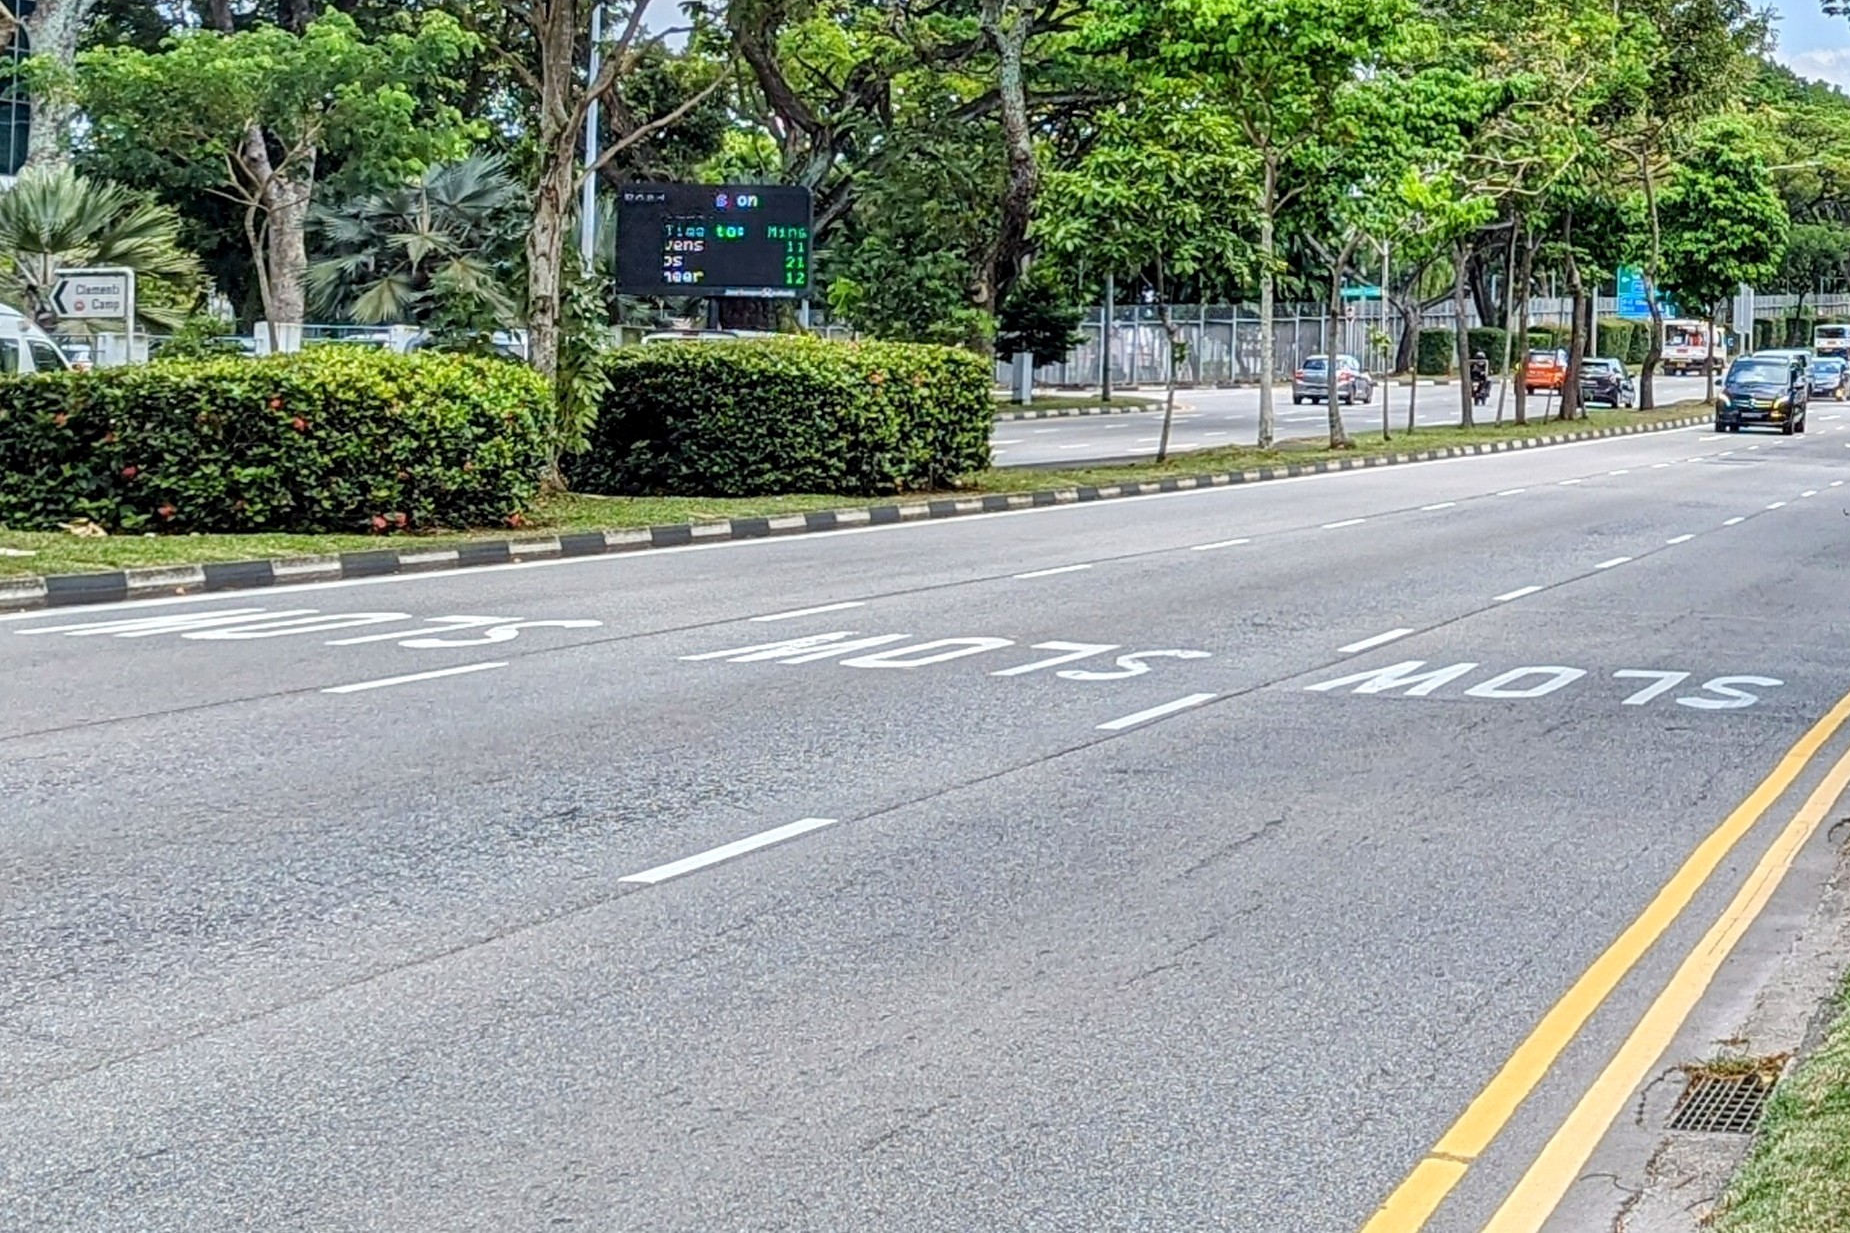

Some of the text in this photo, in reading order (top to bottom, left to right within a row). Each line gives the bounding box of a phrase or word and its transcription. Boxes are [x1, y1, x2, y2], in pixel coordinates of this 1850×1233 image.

[737, 195, 758, 207] on
[787, 240, 805, 253] 11
[785, 256, 805, 269] 21
[786, 271, 805, 285] 12
[75, 283, 121, 296] Clementi
[91, 297, 120, 312] Camp
[14, 607, 603, 649] SLOW
[679, 630, 1213, 681] SLOW
[1303, 660, 1785, 710] SLOW
